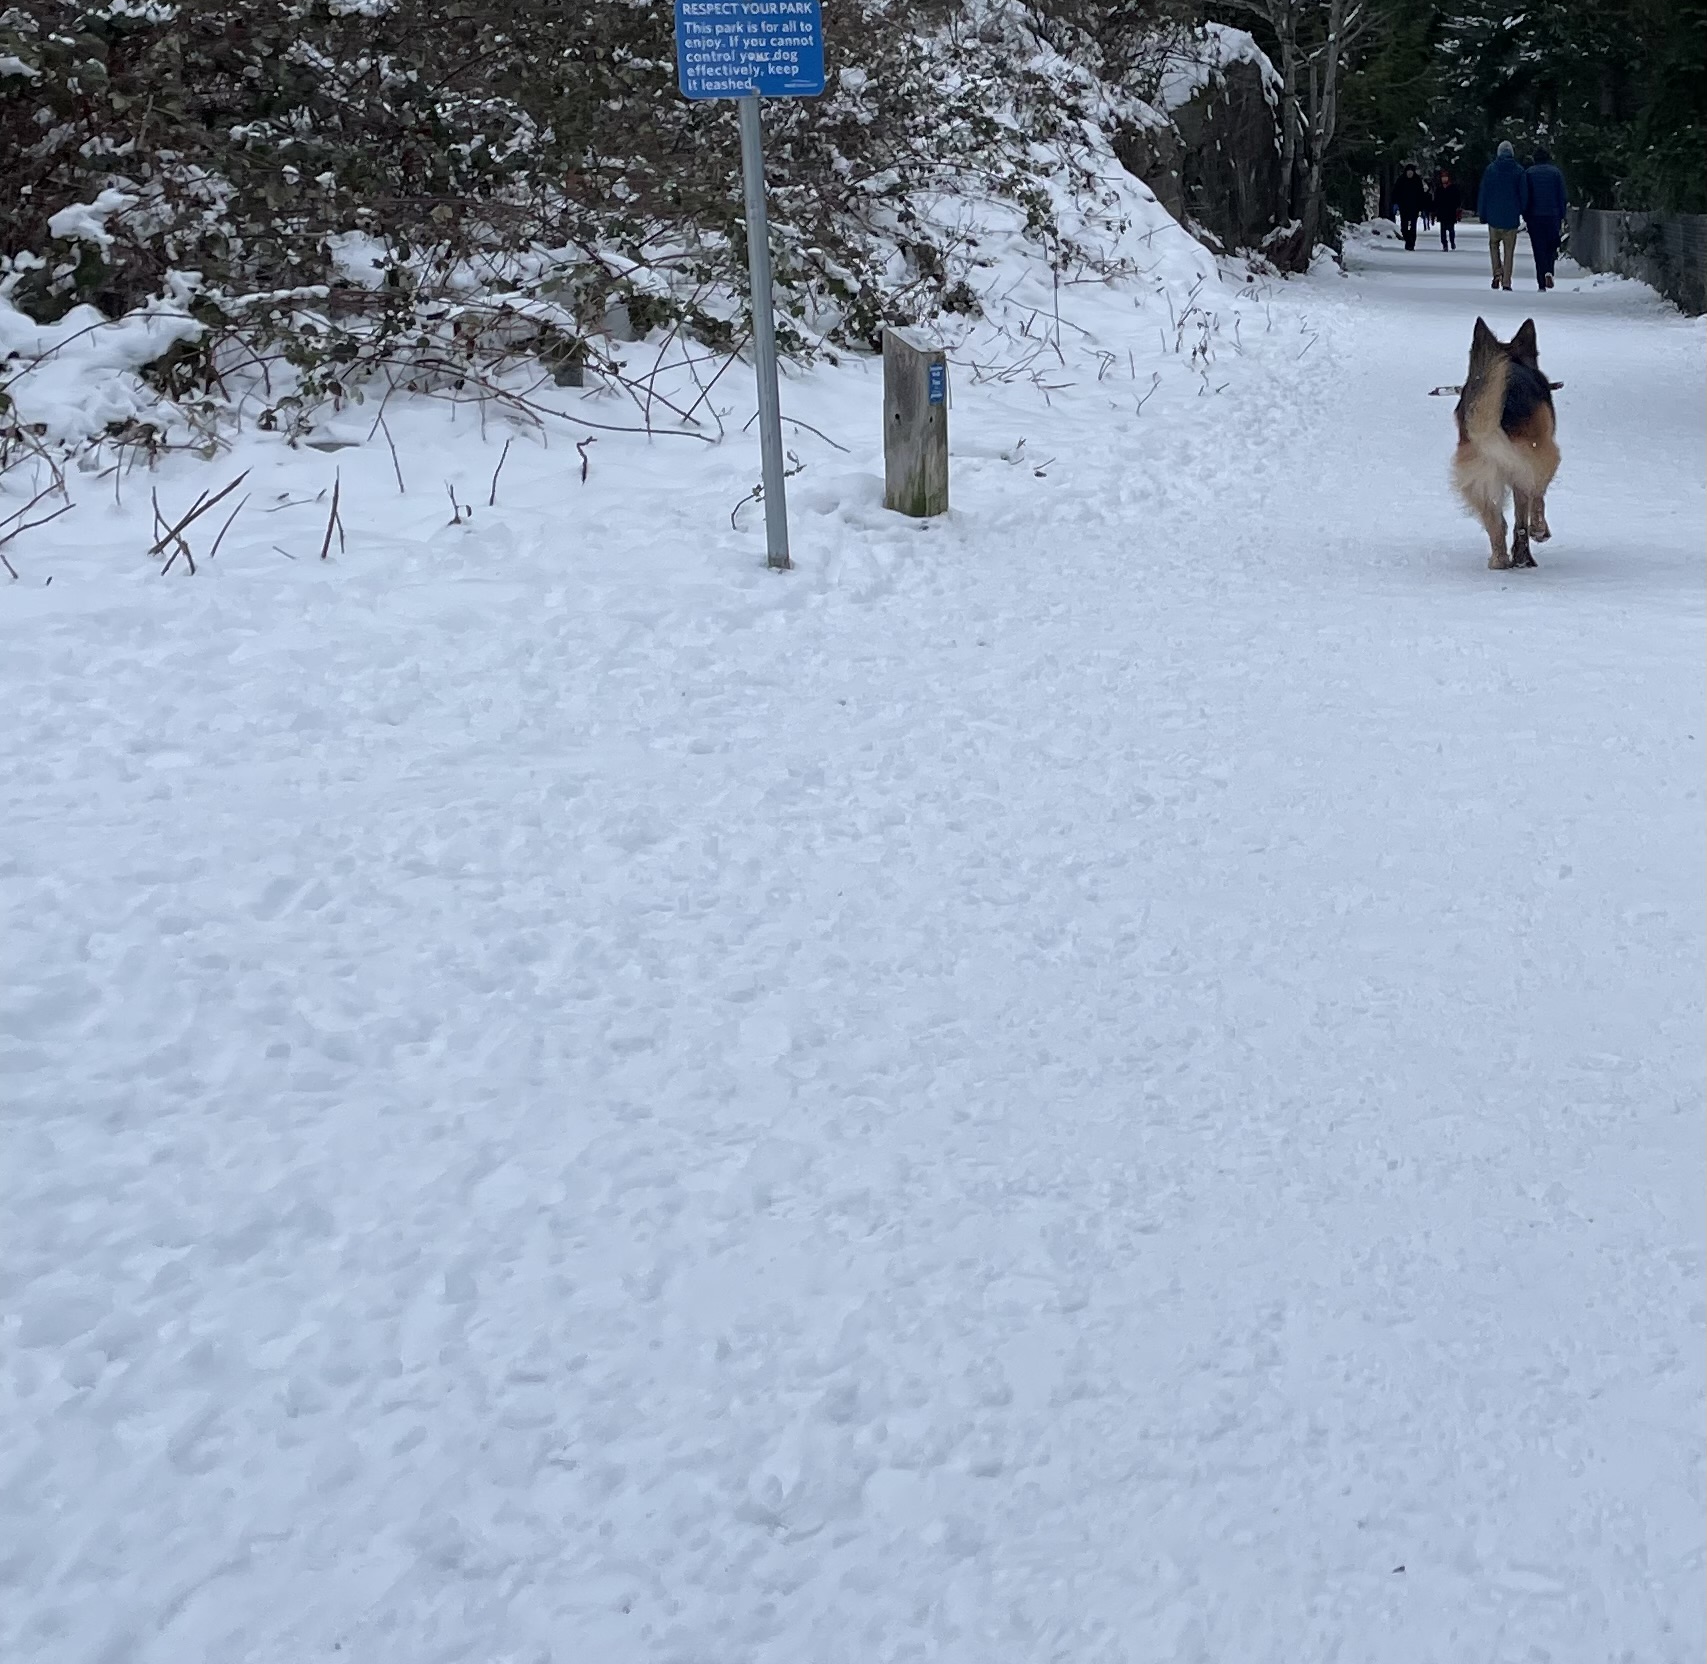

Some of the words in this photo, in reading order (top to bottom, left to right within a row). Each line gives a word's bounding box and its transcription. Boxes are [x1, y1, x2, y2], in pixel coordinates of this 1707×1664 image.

[682, 3, 738, 15] RESPECT
[741, 2, 777, 15] YOUR
[780, 2, 812, 14] PARK
[684, 22, 712, 34] This
[715, 21, 743, 35] park
[747, 22, 758, 33] is
[760, 21, 778, 32] for
[782, 20, 797, 32] all
[800, 21, 813, 32] to
[684, 38, 726, 50] enjoy.
[729, 36, 739, 47] If
[742, 37, 766, 49] you
[770, 36, 814, 47] cannot
[686, 50, 735, 62] control
[740, 52, 770, 64] your
[773, 49, 798, 62] dog
[686, 64, 764, 77] effectively,
[768, 63, 799, 76] keep
[688, 79, 698, 91] it
[701, 78, 756, 91] leashed.
